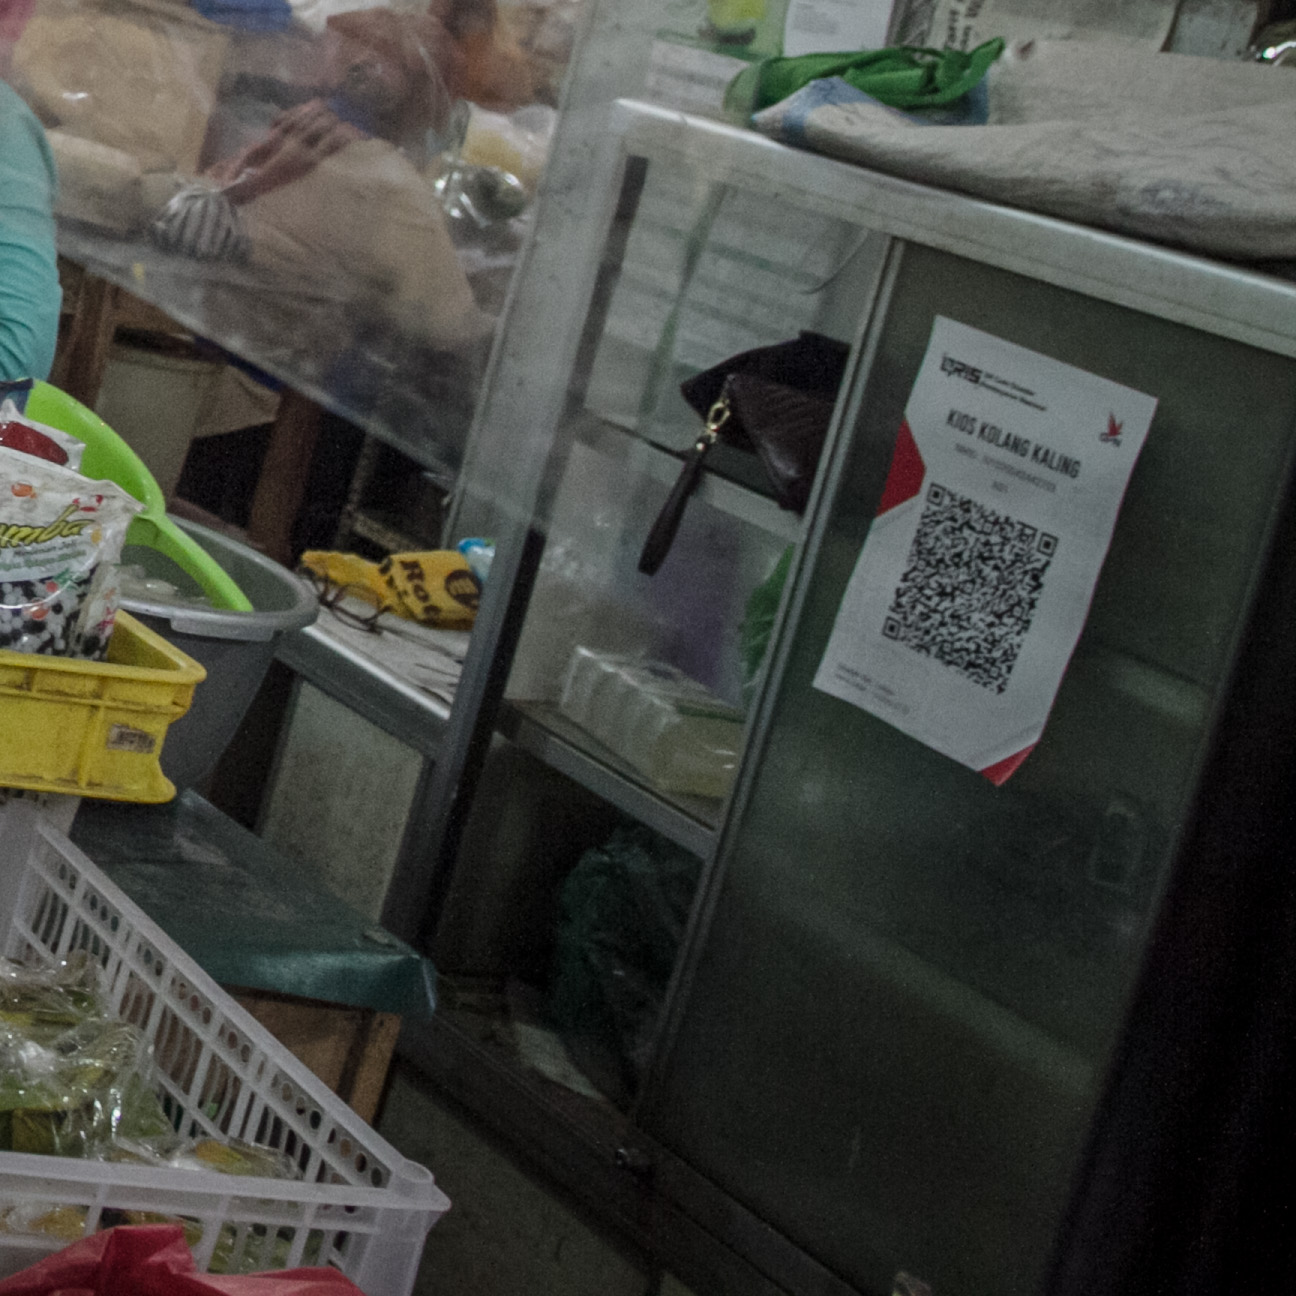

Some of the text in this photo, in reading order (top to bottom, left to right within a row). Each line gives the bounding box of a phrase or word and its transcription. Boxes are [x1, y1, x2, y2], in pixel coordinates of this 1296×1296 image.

[946, 408, 978, 436] KIOS
[977, 421, 1032, 459] KOLANG
[1031, 442, 1082, 480] KALING
